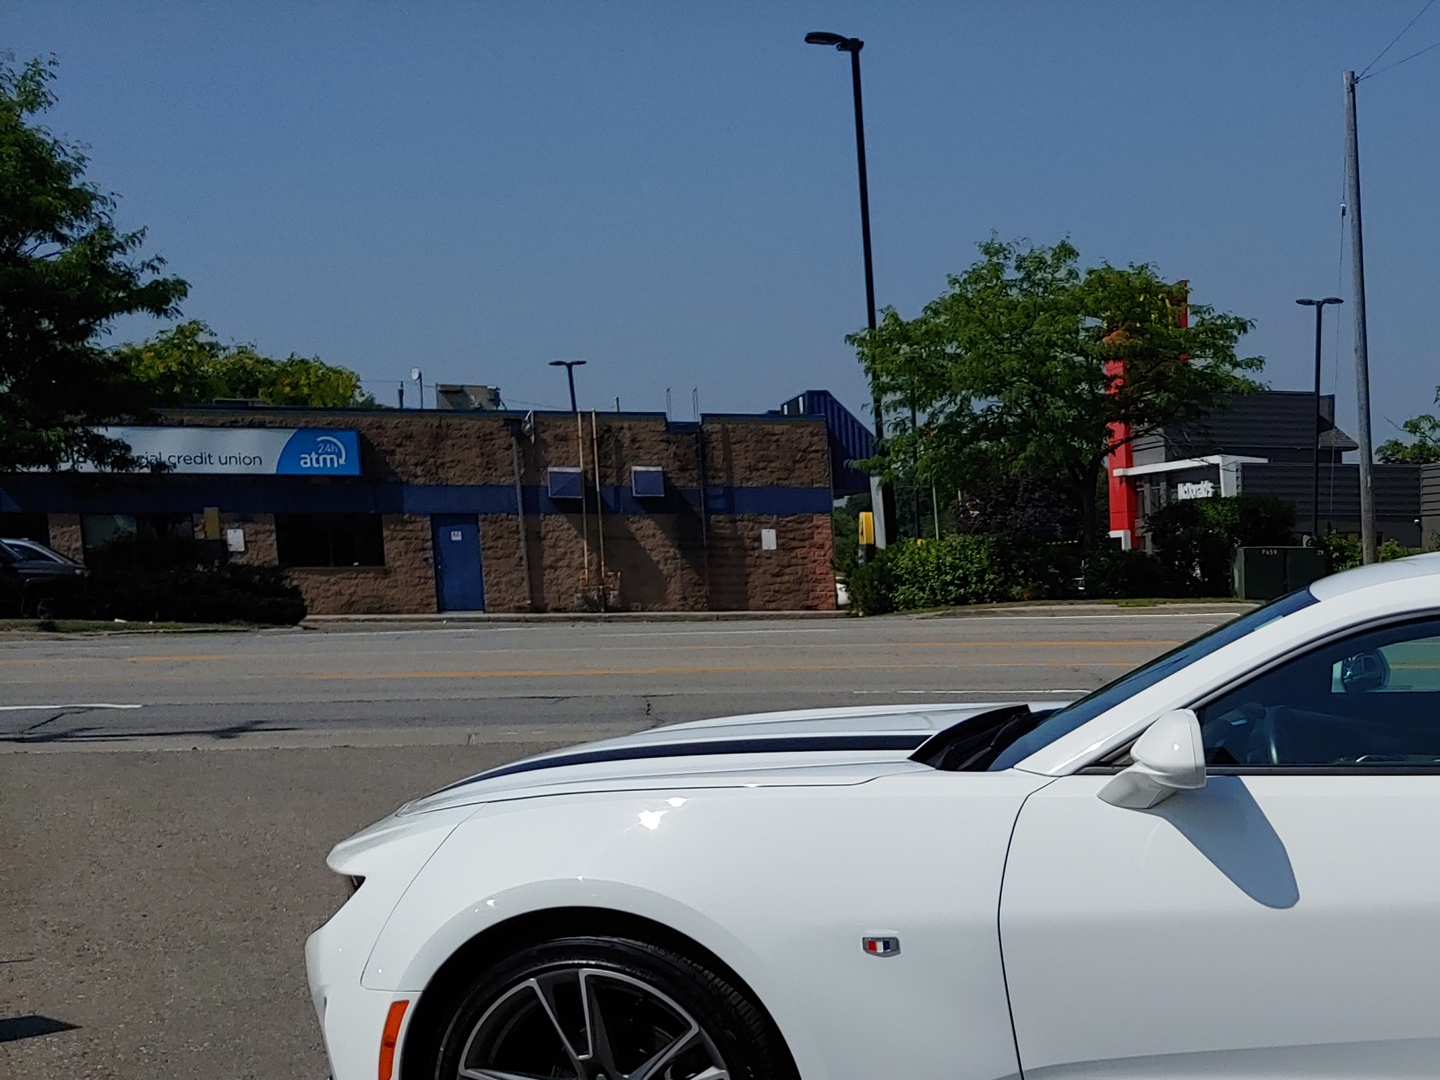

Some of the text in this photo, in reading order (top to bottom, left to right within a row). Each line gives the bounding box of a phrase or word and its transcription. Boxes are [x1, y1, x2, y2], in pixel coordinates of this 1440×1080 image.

[317, 443, 338, 454] 24h
[168, 451, 213, 466] credit
[219, 452, 263, 466] union
[300, 452, 339, 468] atm
